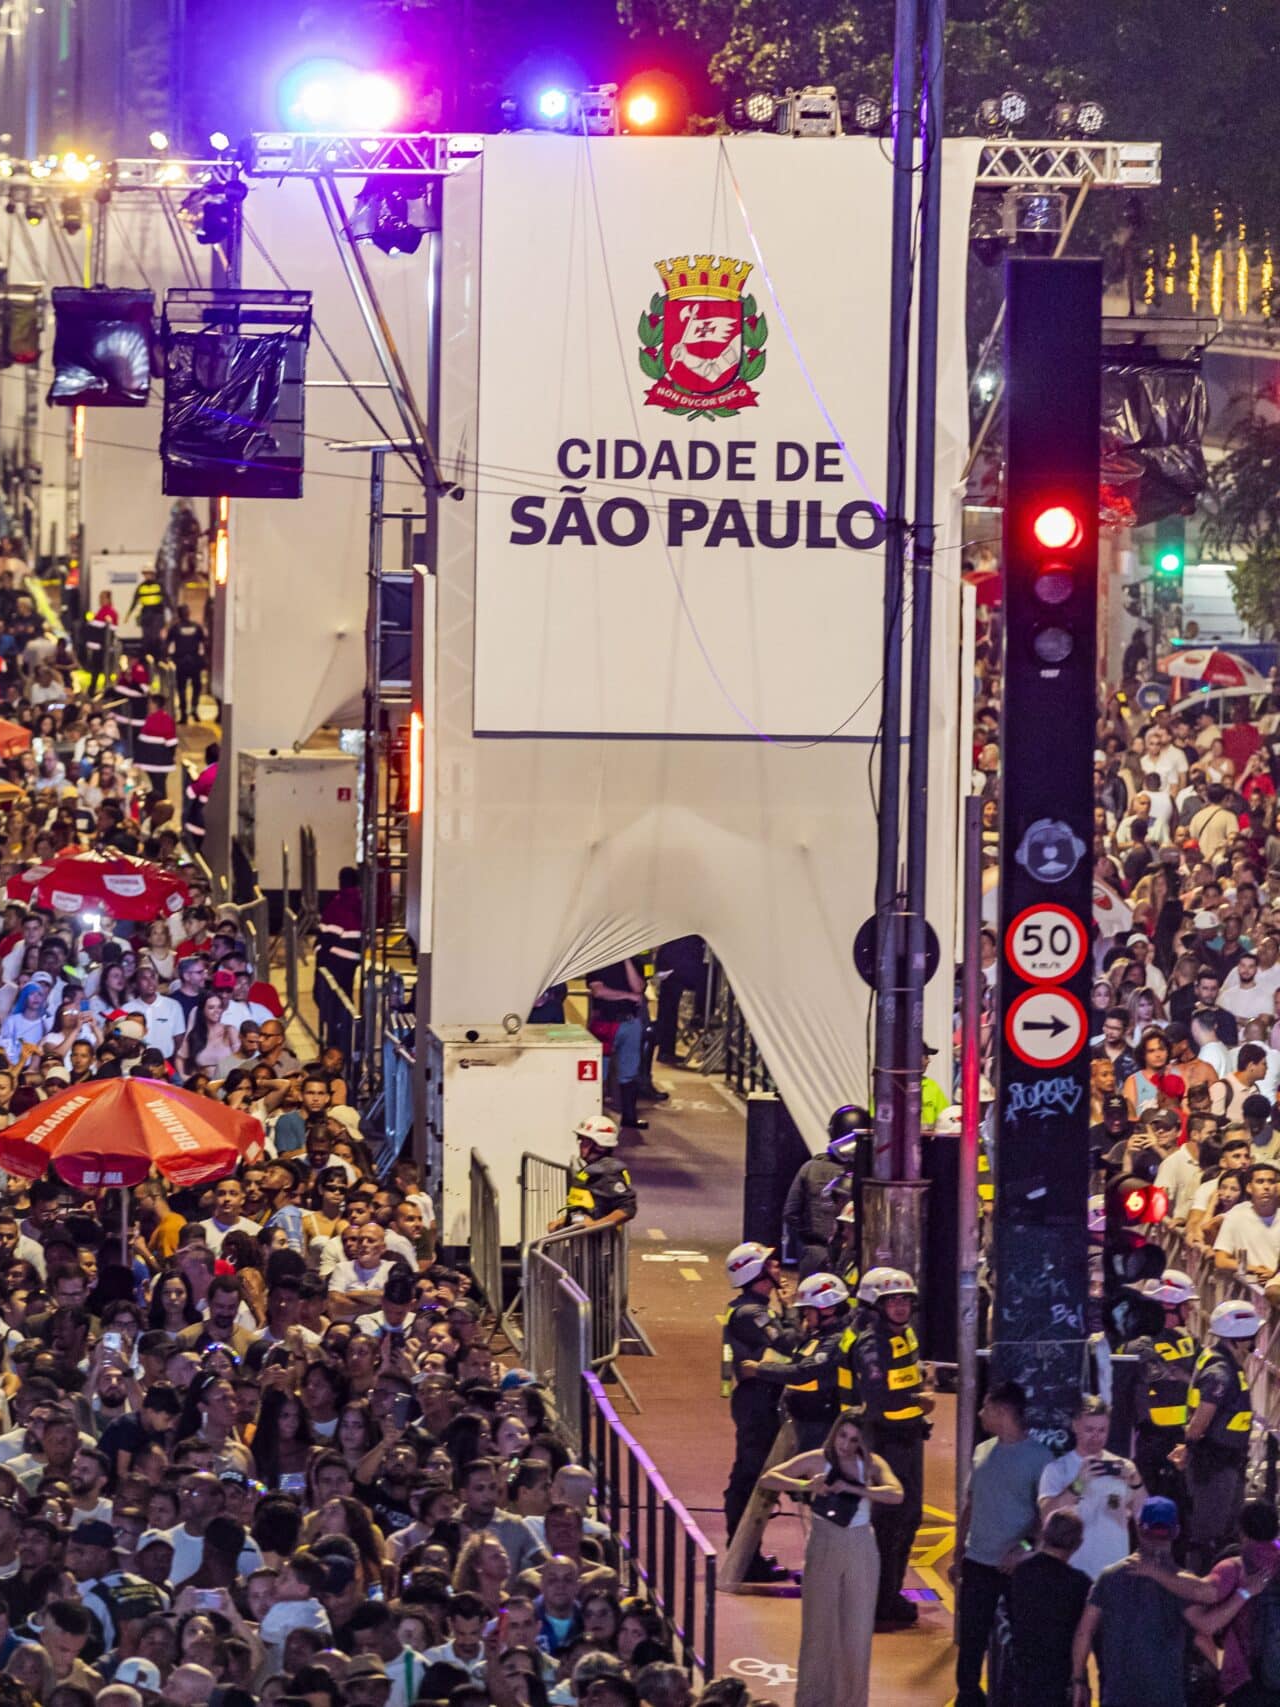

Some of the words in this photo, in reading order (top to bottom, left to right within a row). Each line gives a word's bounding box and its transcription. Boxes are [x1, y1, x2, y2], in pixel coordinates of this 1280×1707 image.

[657, 387, 681, 402] NON
[557, 438, 756, 482] CIDADE
[776, 441, 845, 483] DE
[509, 485, 650, 548] SÃO
[667, 499, 888, 550] PAULO
[1022, 924, 1072, 957] 50
[24, 1095, 93, 1144] BRAHMA
[145, 1099, 201, 1151] BRAHMA
